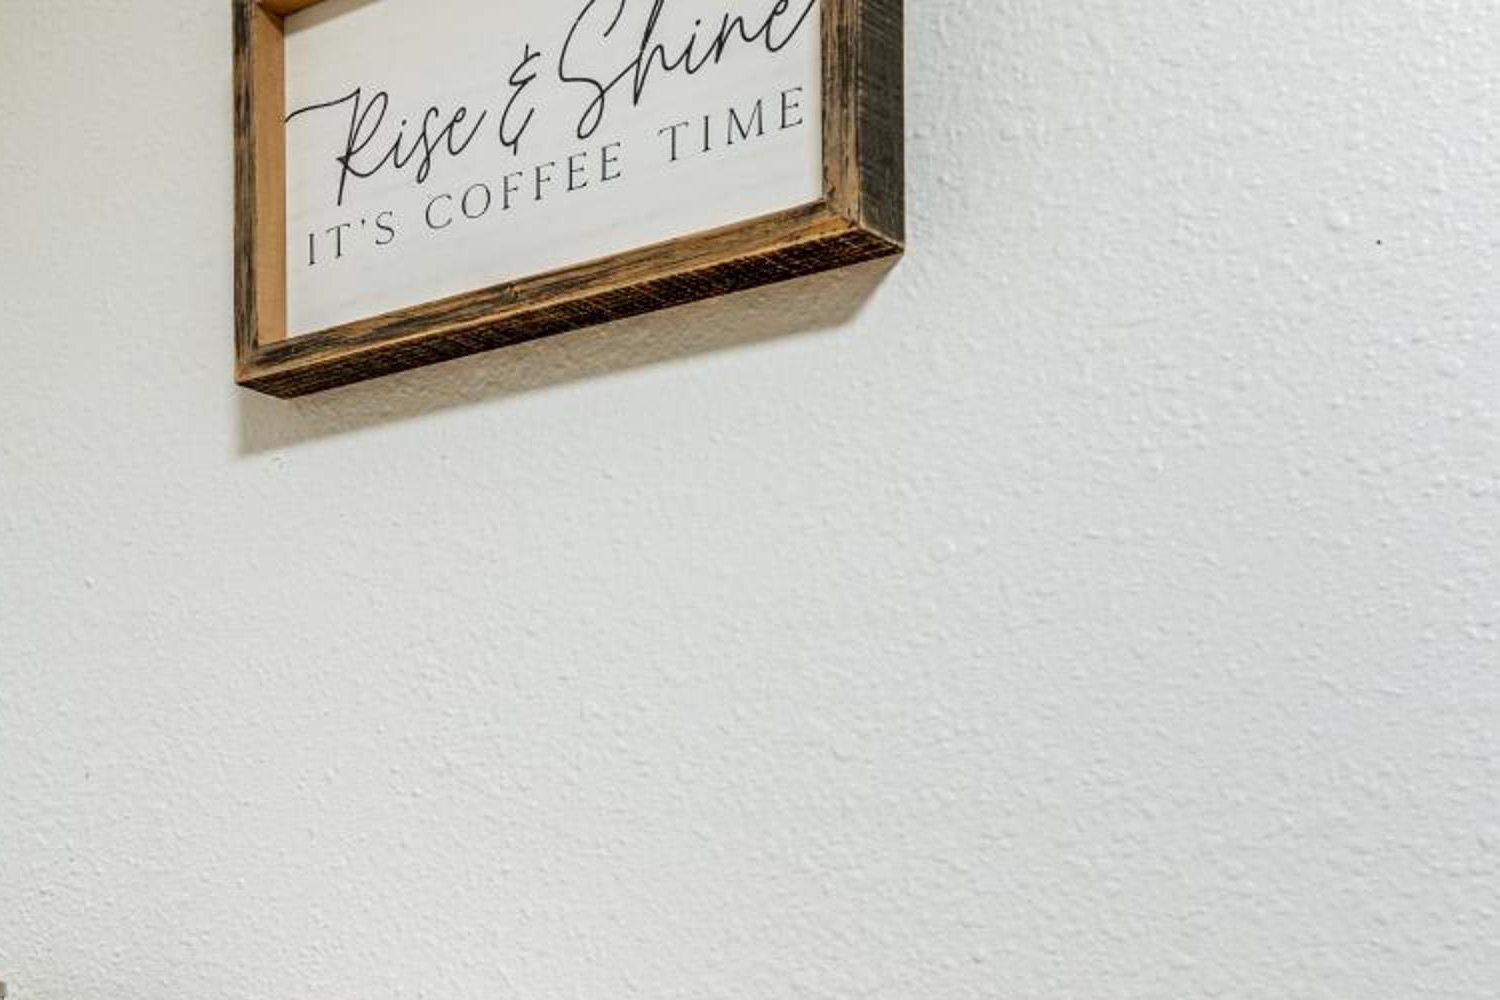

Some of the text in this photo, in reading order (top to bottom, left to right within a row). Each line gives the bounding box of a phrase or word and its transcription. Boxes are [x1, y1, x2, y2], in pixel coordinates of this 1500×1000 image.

[285, 0, 814, 206] Rise & Shine
[307, 86, 806, 267] IT'S COFFEE TIME
